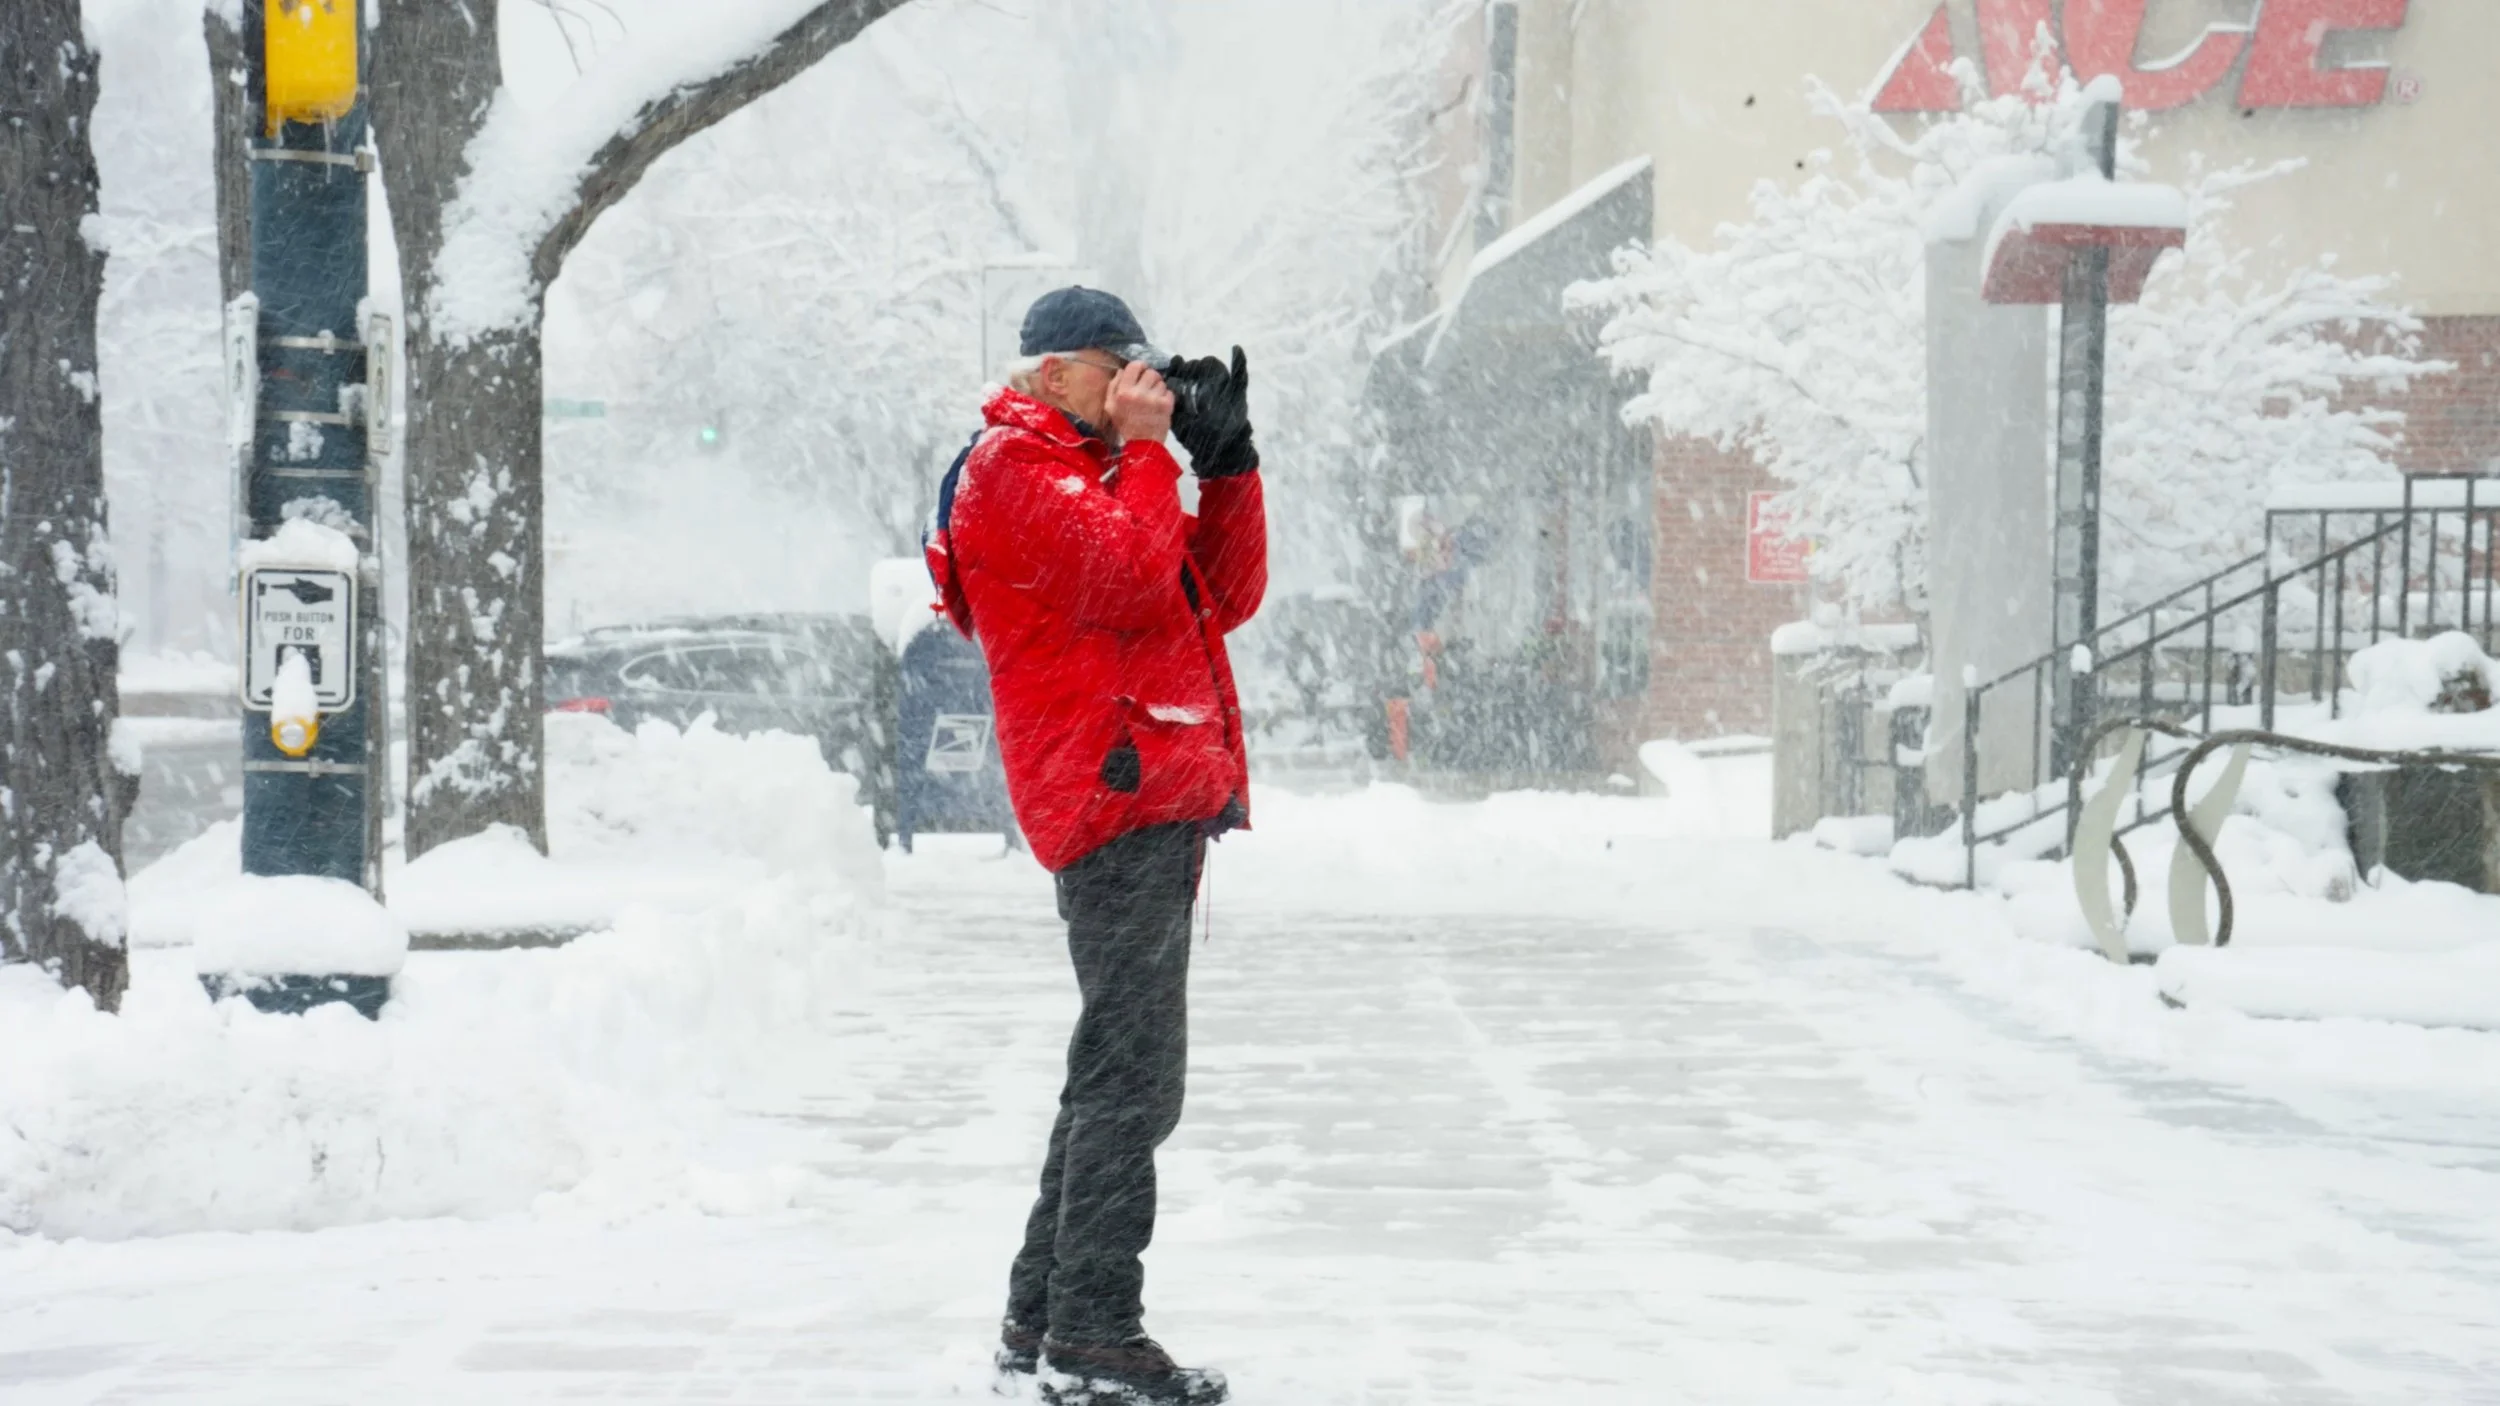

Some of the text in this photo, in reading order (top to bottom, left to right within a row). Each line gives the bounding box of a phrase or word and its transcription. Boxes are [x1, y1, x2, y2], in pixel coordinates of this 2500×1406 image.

[264, 611, 335, 623] PUSH BUTTON
[283, 626, 315, 640] FOR
